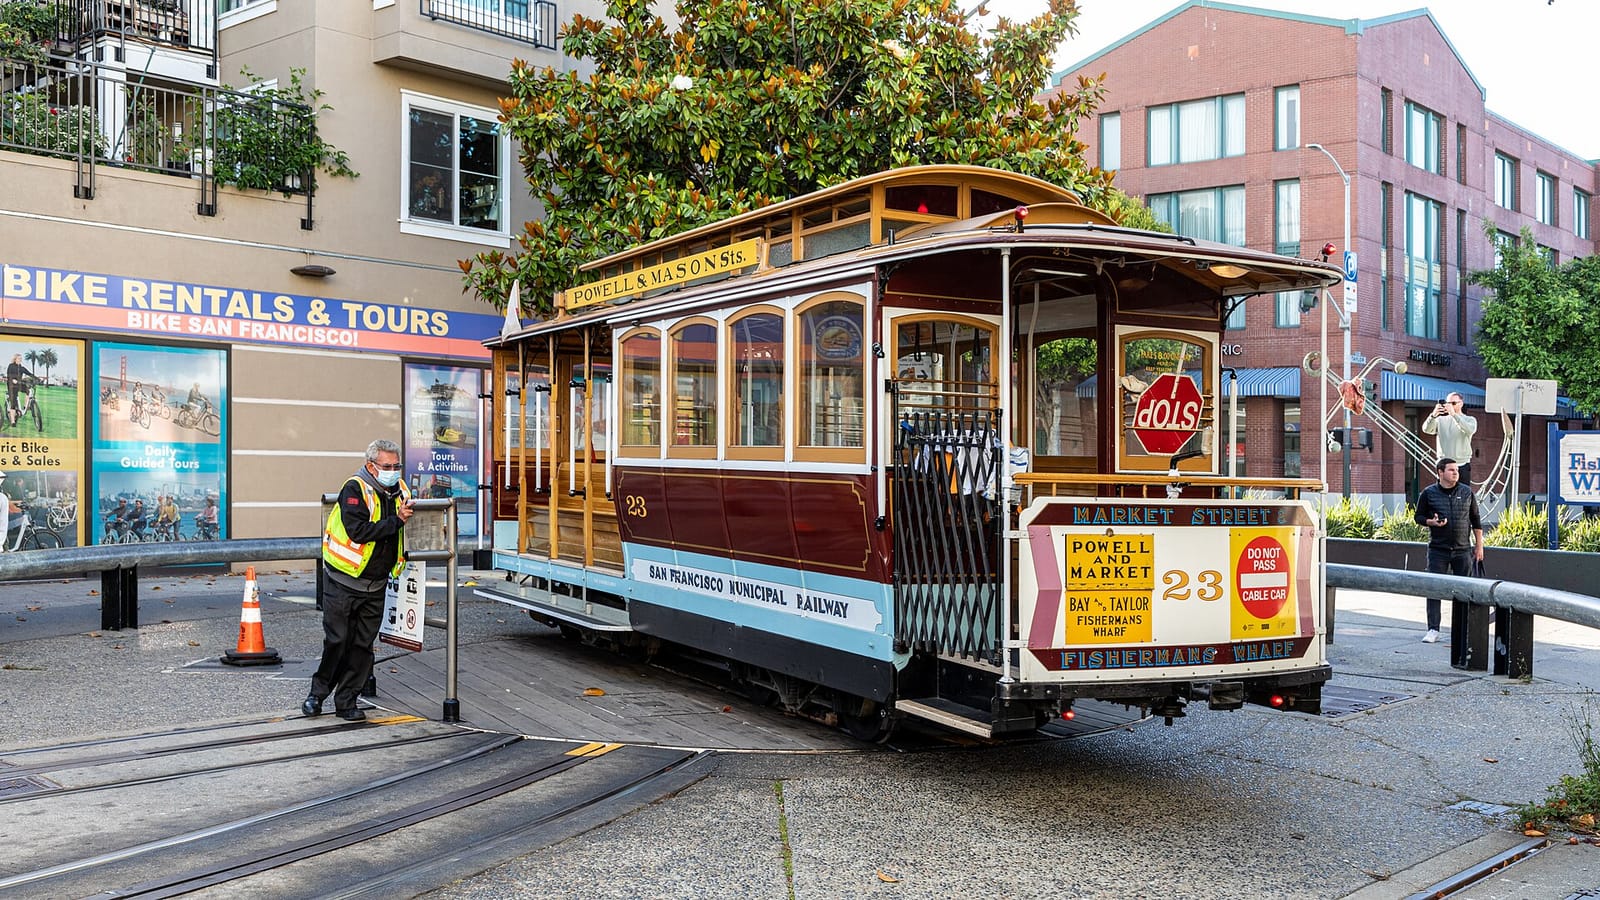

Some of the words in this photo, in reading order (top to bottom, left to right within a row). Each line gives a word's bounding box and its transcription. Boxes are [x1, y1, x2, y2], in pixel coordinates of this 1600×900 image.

[573, 278, 634, 304] POWELL
[636, 273, 648, 289] &
[650, 254, 717, 286] MASON
[720, 249, 747, 268] Sts.
[3, 266, 109, 305] BIKE
[122, 279, 295, 323] RENTALS
[306, 299, 331, 326] &
[341, 301, 449, 337] TOURS
[127, 311, 182, 332] BIKE
[187, 316, 233, 336] SAN
[239, 320, 359, 346] FRANCISCO!
[1137, 399, 1199, 430] STOP
[0, 443, 16, 453] ric
[21, 442, 49, 454] Bike
[144, 445, 177, 459] Daily
[12, 456, 22, 466] &
[26, 455, 61, 467] Sales
[431, 451, 456, 461] Tours
[120, 457, 164, 469] Guided
[168, 457, 200, 470] Tours
[417, 462, 425, 472] &
[427, 462, 468, 472] Activities
[625, 494, 648, 518] 23
[1073, 506, 1175, 525] MARKET
[1191, 507, 1272, 526] STREET
[1072, 541, 1150, 554] POWELL
[1247, 548, 1263, 559] DO
[1264, 547, 1281, 558] NOT
[1093, 555, 1131, 564] AND
[1253, 560, 1276, 571] PASS
[1070, 565, 1152, 579] MARKET
[1162, 569, 1224, 602] 23
[649, 565, 668, 582] SAN
[669, 568, 724, 594] FRANCISCO
[728, 579, 788, 607] MUNICIPAL
[796, 593, 849, 620] RAILWAY
[1242, 589, 1268, 602] CABLE
[1270, 589, 1287, 600] CAR
[1069, 598, 1090, 612] BAY
[1110, 597, 1149, 612] TAYLOR
[1077, 615, 1143, 626] FISHERMANS
[1093, 626, 1127, 637] WHARF
[1060, 647, 1217, 670] FISHERMANS
[1233, 641, 1295, 662] WHARF
